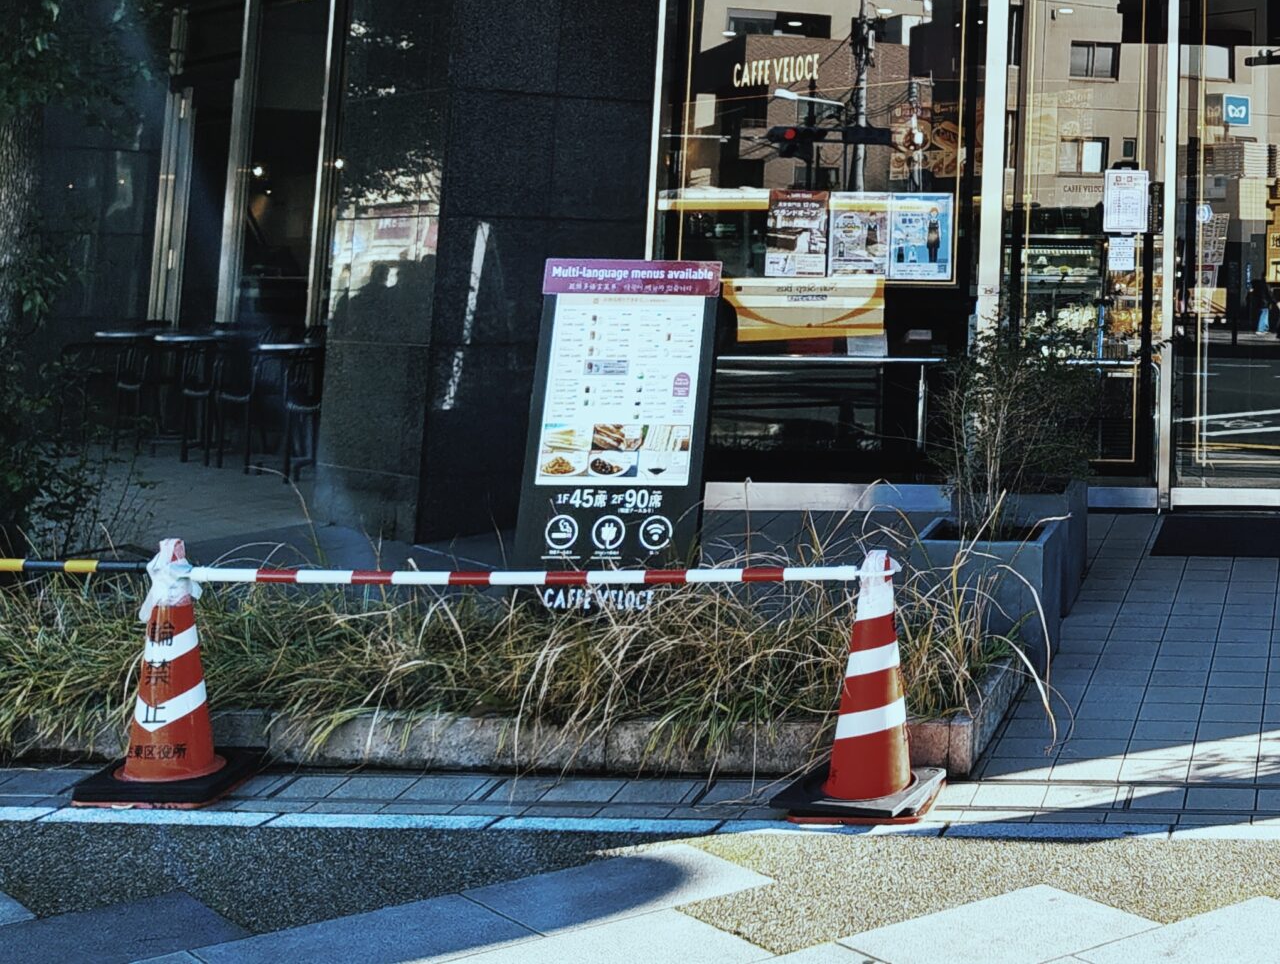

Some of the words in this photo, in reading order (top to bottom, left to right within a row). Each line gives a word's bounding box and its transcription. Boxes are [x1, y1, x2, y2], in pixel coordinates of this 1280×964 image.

[773, 52, 820, 84] VELOCE
[552, 266, 628, 281] Multi-language
[631, 270, 664, 280] menus
[667, 267, 713, 280] available
